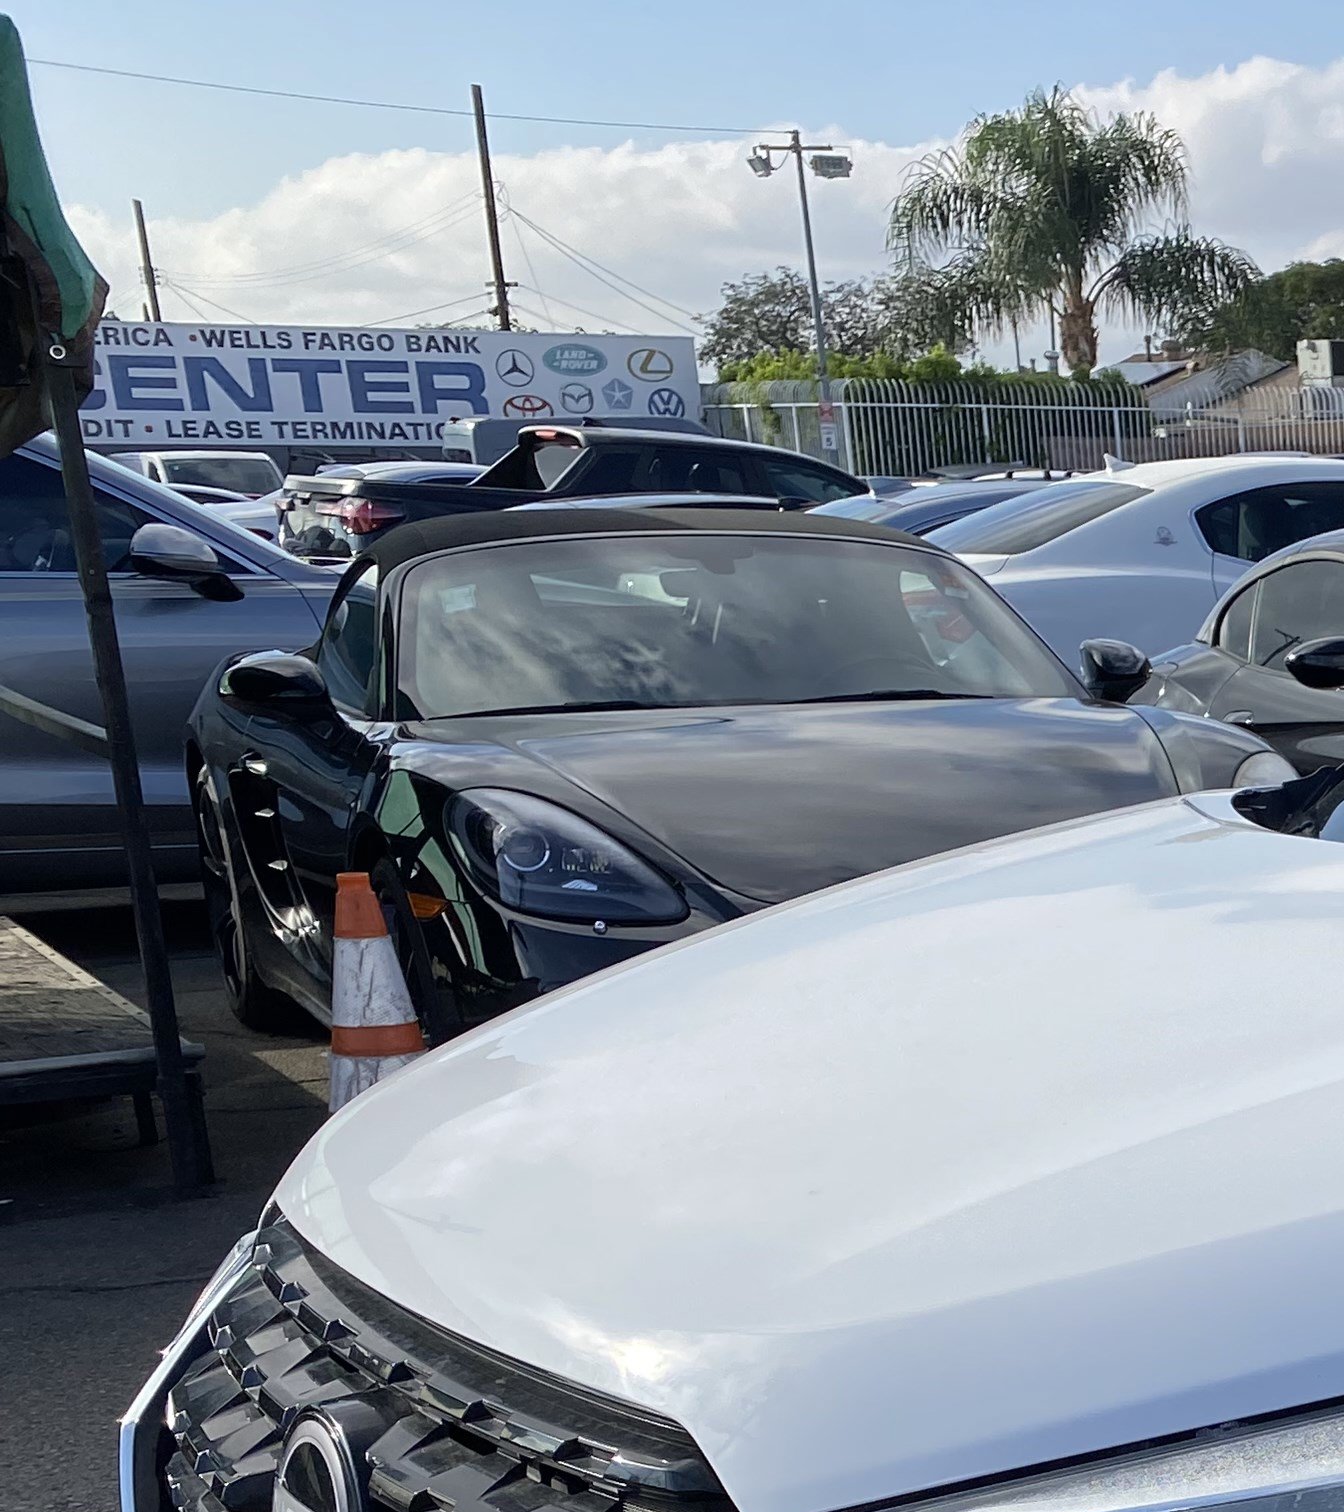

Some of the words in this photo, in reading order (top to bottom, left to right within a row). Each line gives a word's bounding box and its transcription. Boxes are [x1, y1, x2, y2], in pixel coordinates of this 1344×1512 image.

[94, 326, 173, 346] RICA
[198, 329, 292, 349] WELLS
[302, 332, 394, 352] FARGO
[405, 334, 481, 354] BANK
[79, 354, 490, 415] ENTER
[165, 420, 262, 439] LEASE
